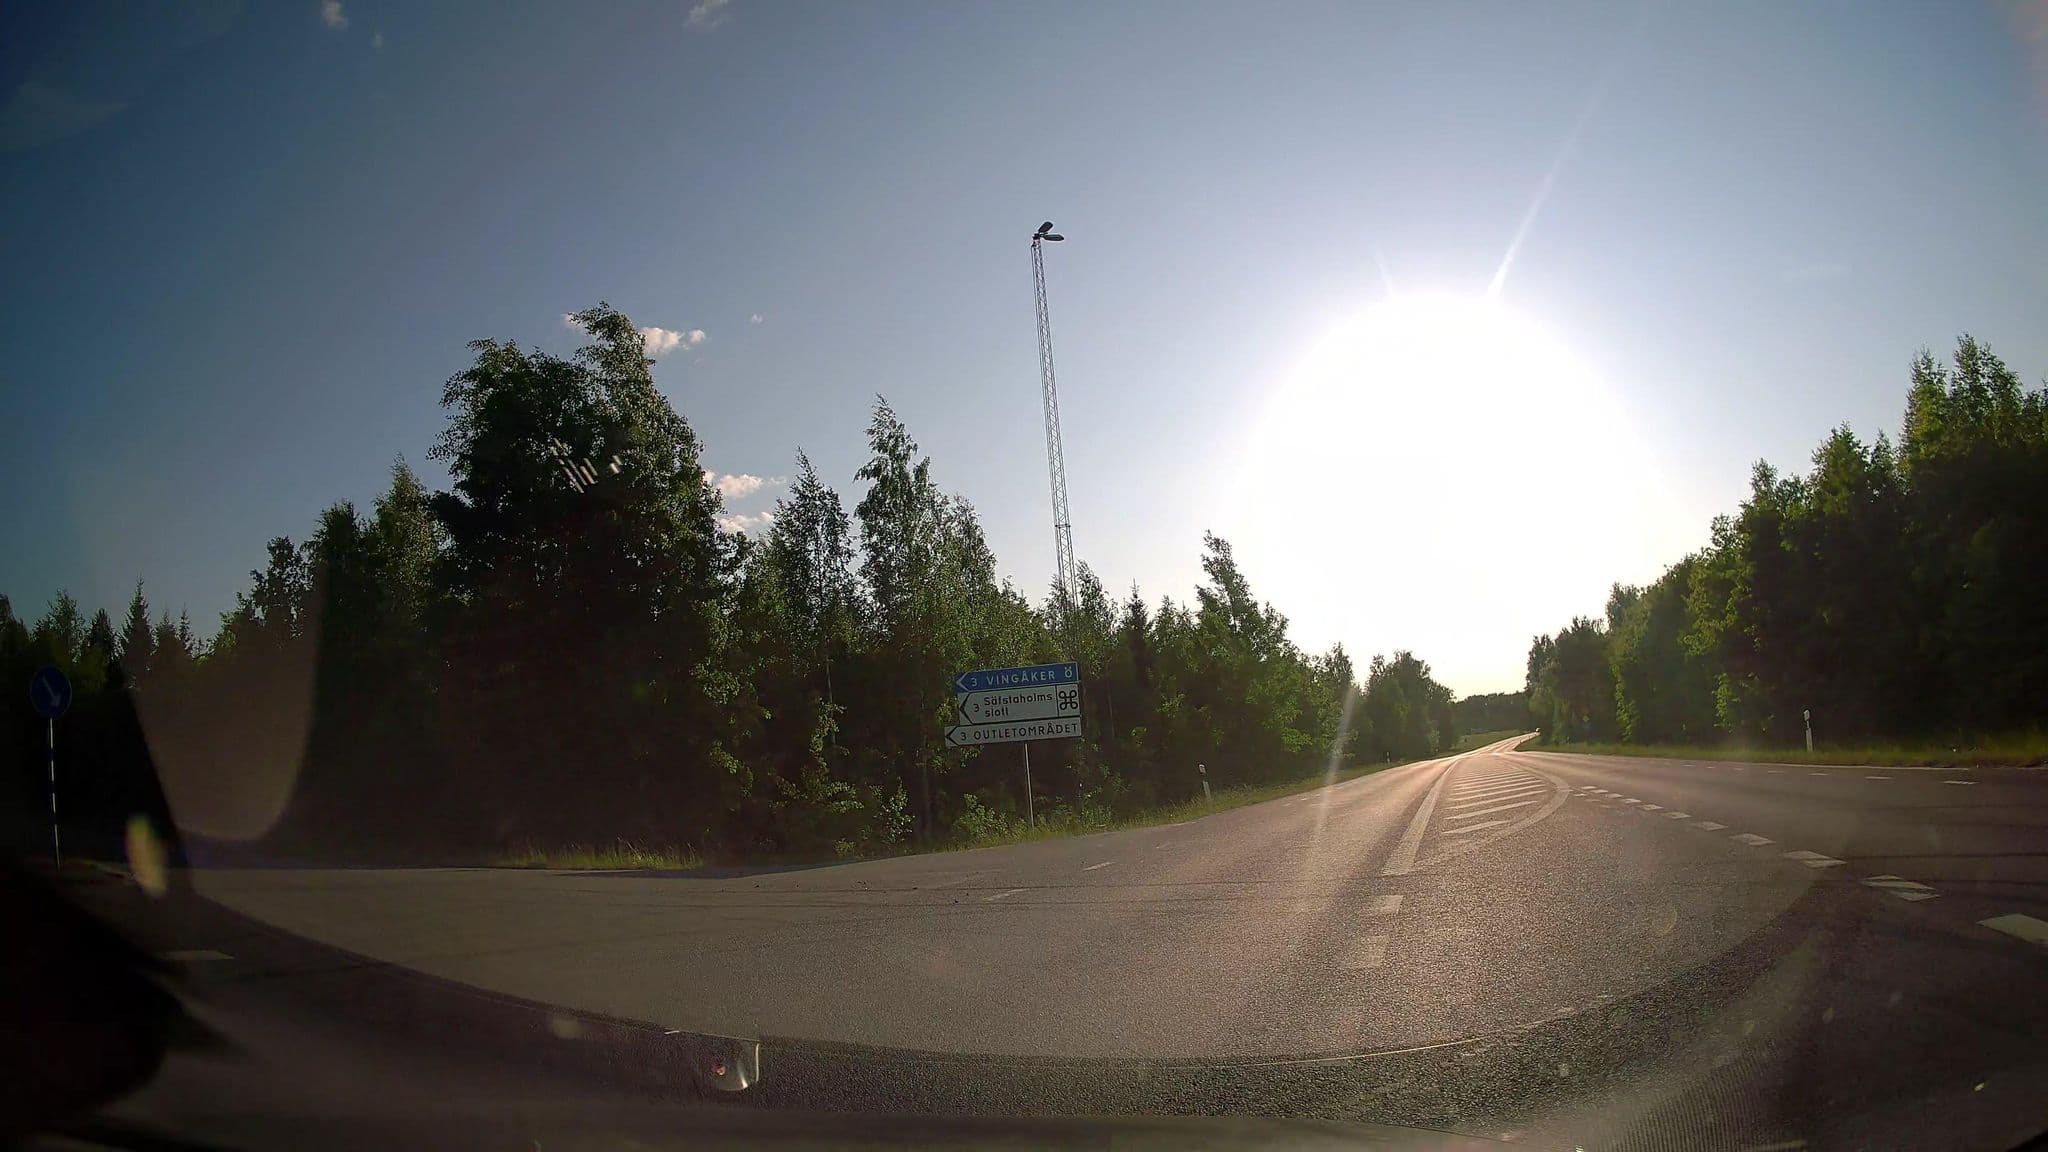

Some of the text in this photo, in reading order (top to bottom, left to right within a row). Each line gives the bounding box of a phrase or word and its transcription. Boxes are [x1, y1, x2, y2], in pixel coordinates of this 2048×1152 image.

[971, 666, 1073, 687] 3 VINGÅKER Ö
[973, 692, 1053, 713] 3 Säfstaholms
[984, 706, 1009, 718] slott
[960, 722, 1078, 741] 3 OUTLETOMRÅDET
